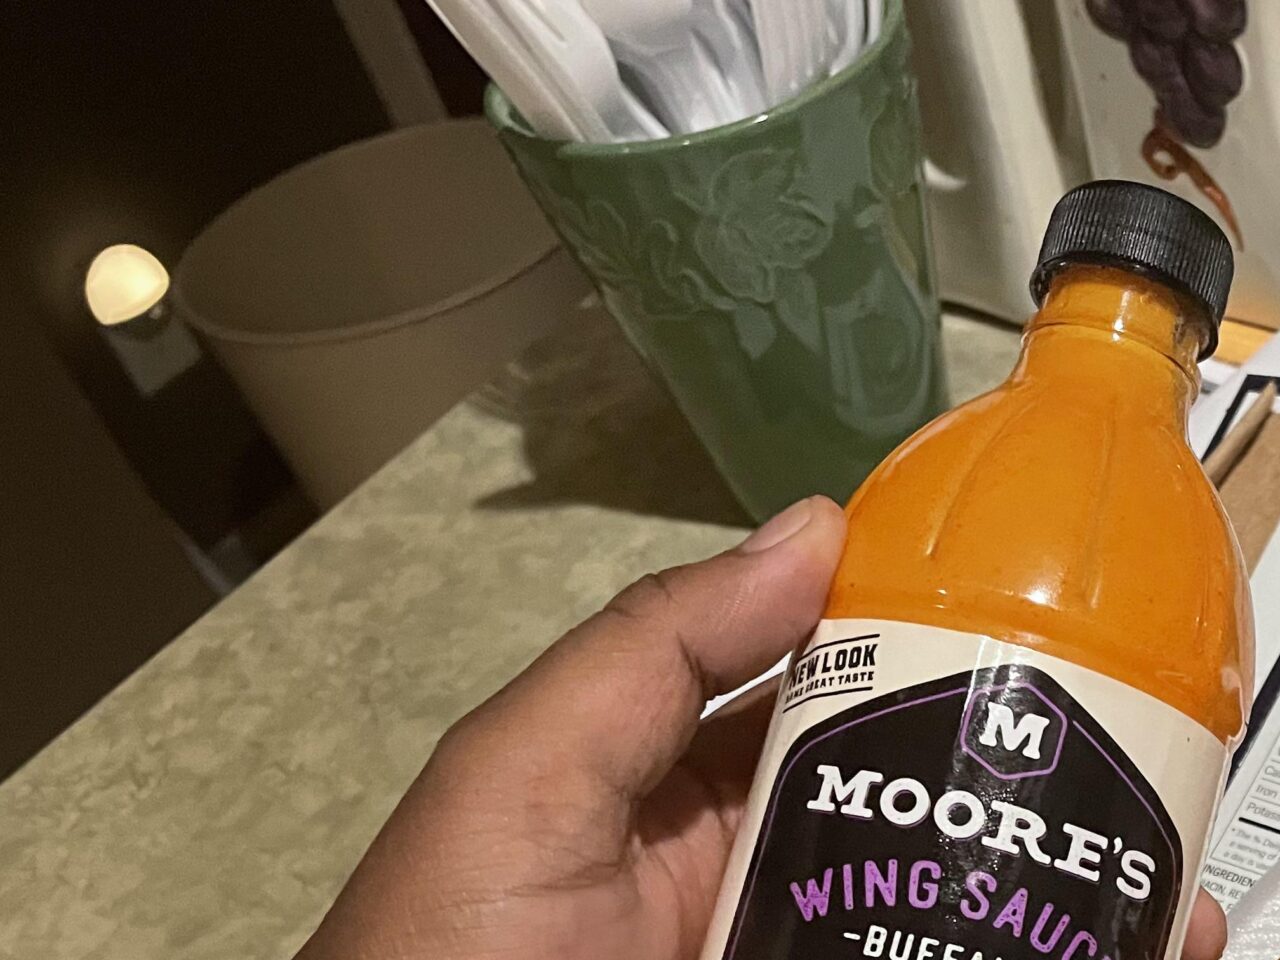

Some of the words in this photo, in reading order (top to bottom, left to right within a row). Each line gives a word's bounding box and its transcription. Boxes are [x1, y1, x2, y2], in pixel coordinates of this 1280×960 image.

[789, 654, 821, 691] NEW
[821, 643, 878, 674] LOOK
[804, 677, 836, 694] GREAT
[837, 671, 875, 686] TASTE
[978, 701, 1051, 760] M
[1254, 783, 1280, 801] Iron
[806, 763, 1157, 902] MOORE'S
[790, 858, 943, 922] WING
[1201, 864, 1257, 889] INGREDIEN
